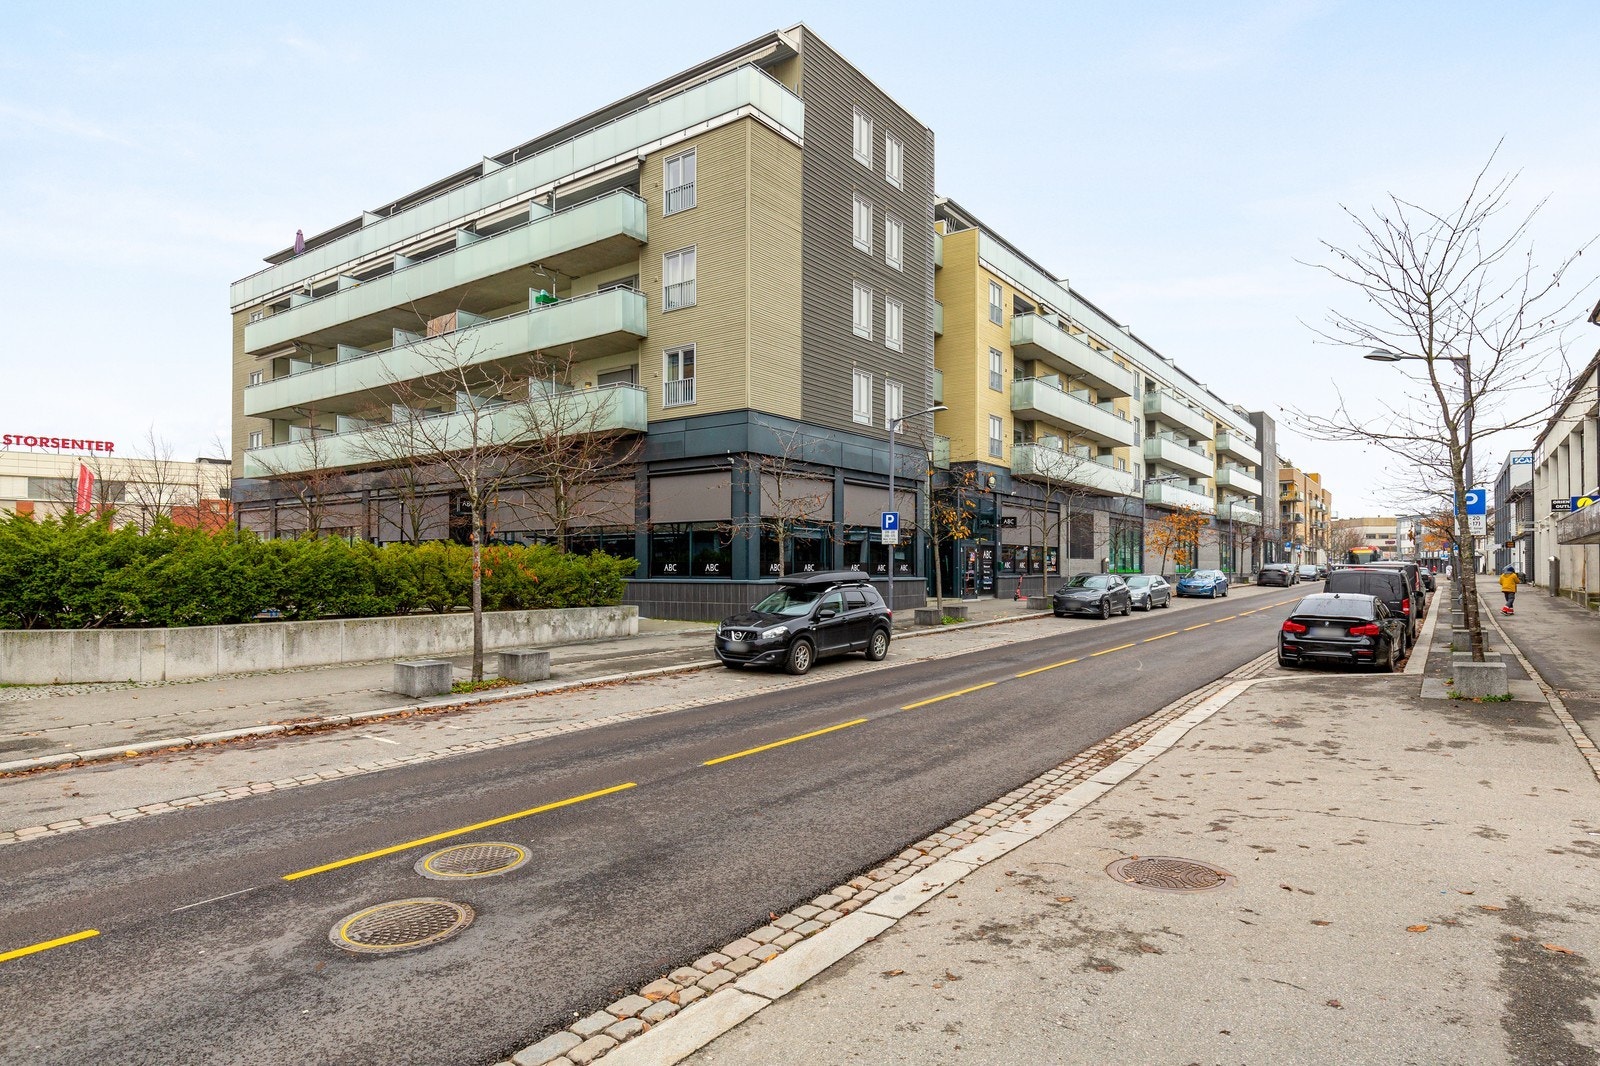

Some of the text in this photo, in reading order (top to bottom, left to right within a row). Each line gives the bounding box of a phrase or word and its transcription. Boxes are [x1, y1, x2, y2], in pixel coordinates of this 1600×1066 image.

[3, 434, 115, 452] STORSENTER
[885, 514, 895, 529] P
[983, 550, 992, 559] ABC
[663, 563, 677, 572] ABC
[704, 563, 719, 572] ABC
[803, 563, 815, 572] ABC
[850, 563, 860, 572] ABC
[877, 564, 886, 572] ABC
[899, 564, 909, 572] ABC
